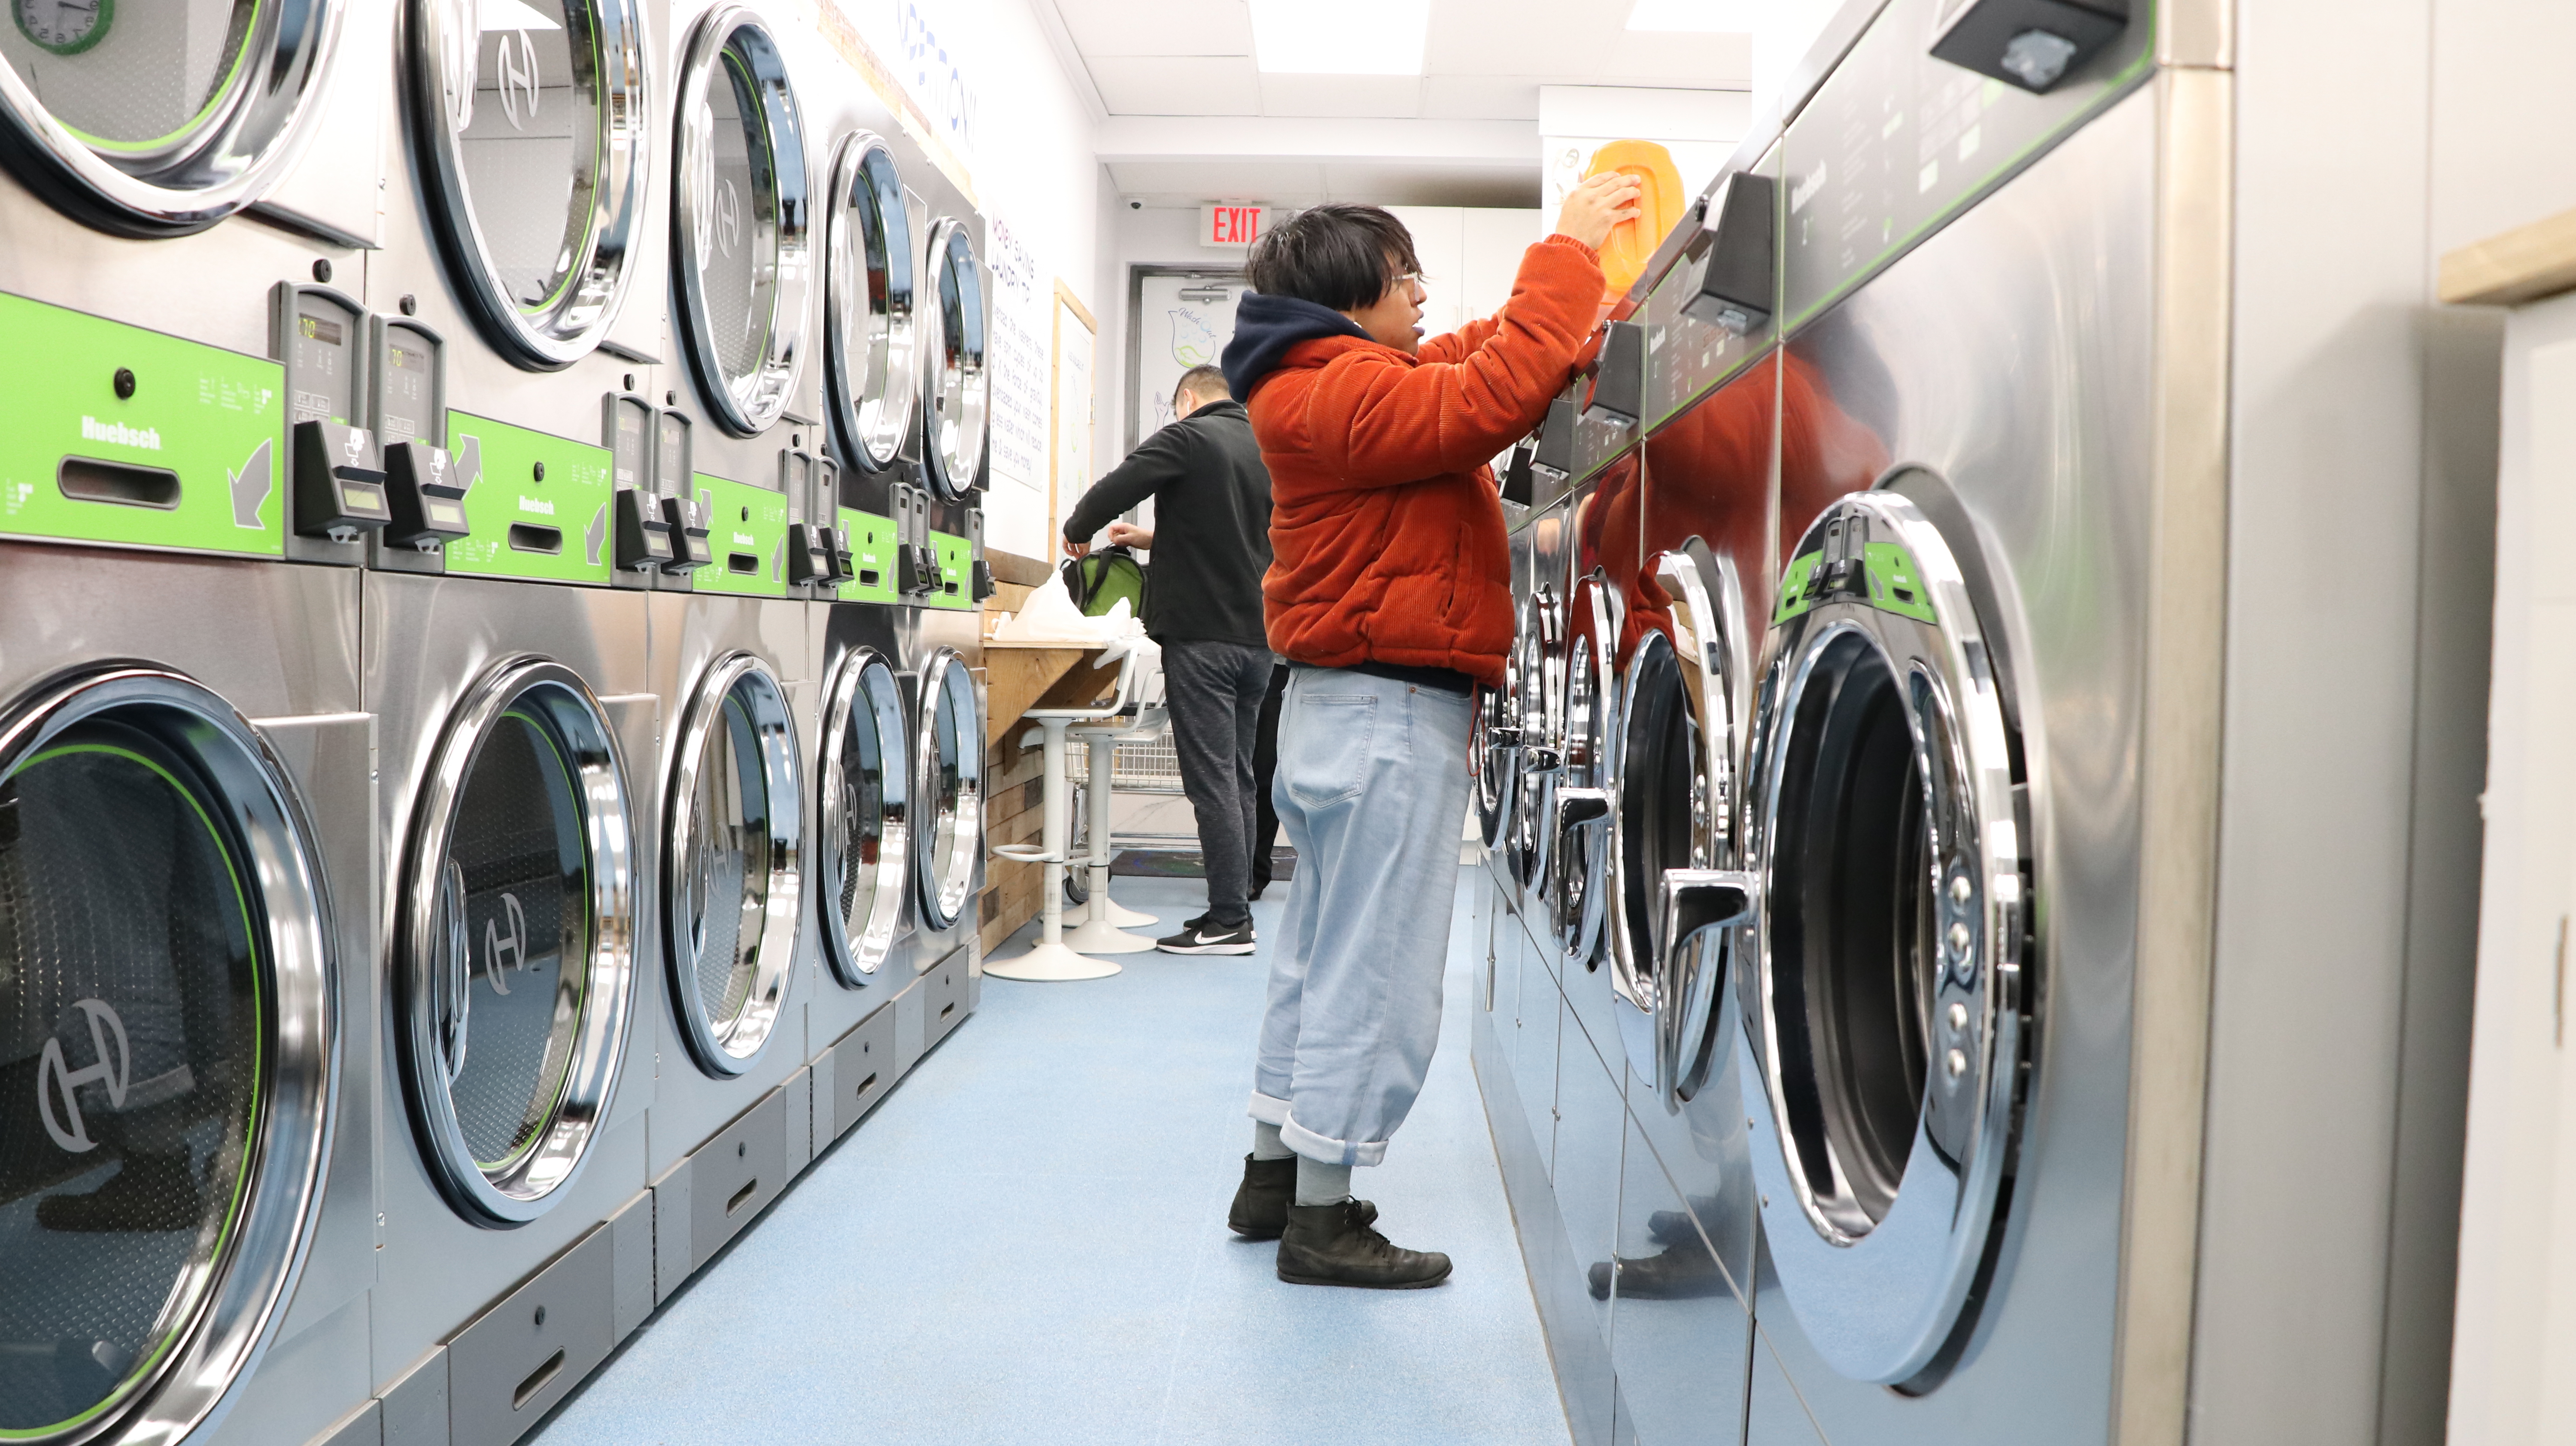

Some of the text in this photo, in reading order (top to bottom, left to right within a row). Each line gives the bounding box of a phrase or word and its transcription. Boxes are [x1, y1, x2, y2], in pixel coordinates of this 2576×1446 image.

[1213, 207, 1261, 243] EXIT
[992, 211, 1034, 279] MONEY SAVING
[991, 246, 1020, 297] LAUNDRY
[1179, 307, 1201, 325] Wash
[82, 415, 161, 450] Huebsch
[519, 495, 554, 515] Huebsch
[733, 532, 754, 546] Huebsch
